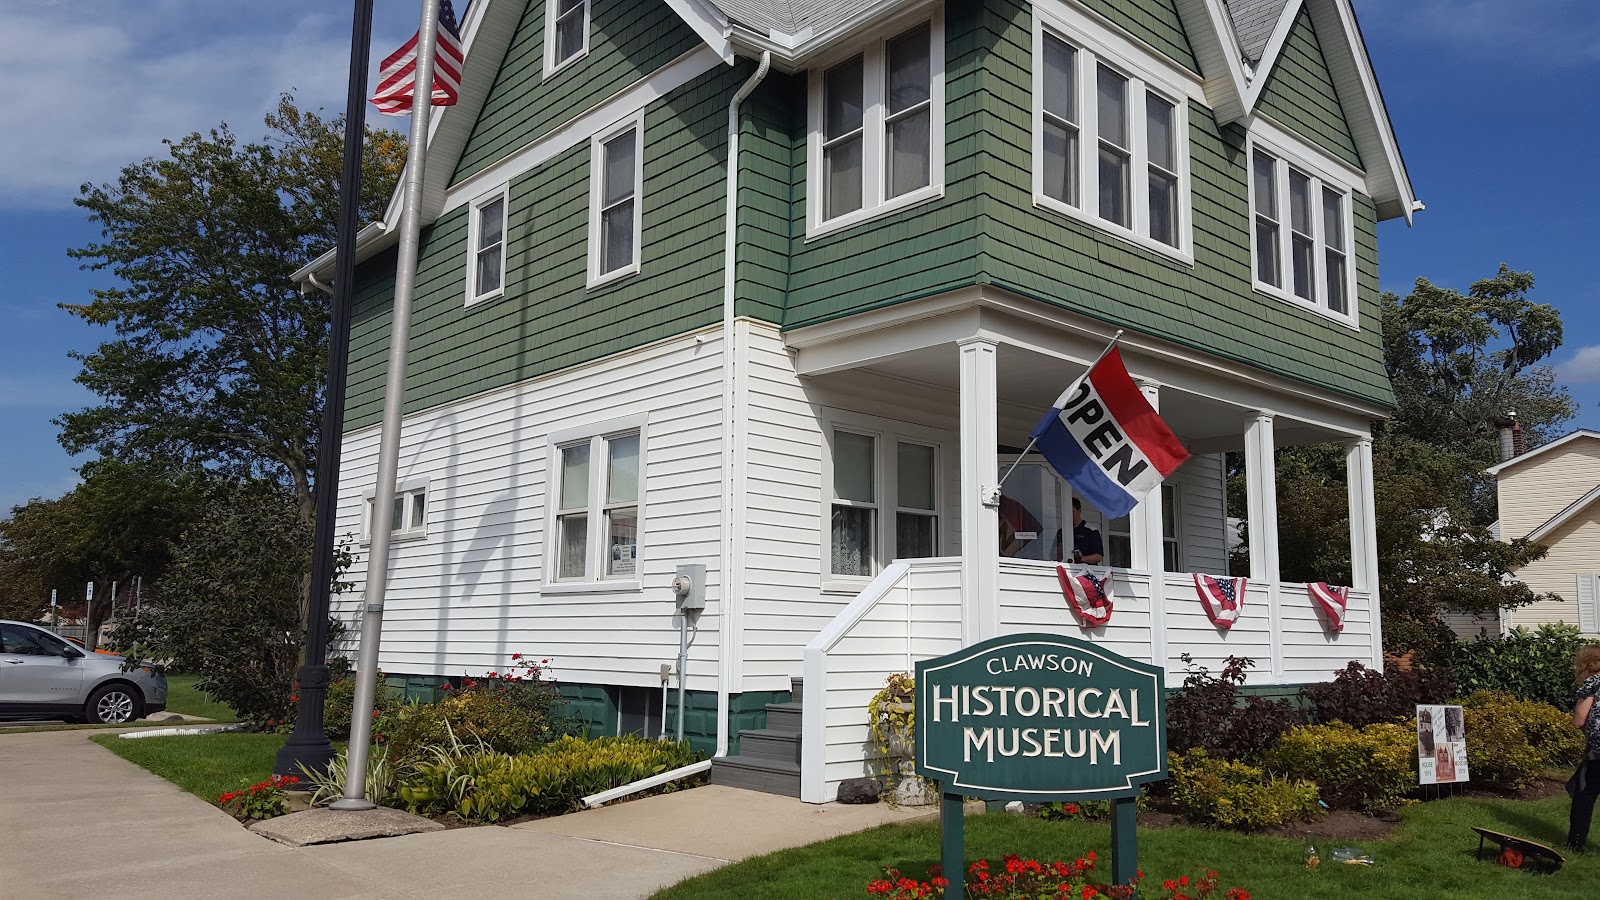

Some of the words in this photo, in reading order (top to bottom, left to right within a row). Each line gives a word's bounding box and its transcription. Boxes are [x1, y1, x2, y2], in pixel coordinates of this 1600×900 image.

[1063, 383, 1148, 486] OPEN
[986, 653, 1093, 678] CLAWSON
[932, 684, 1150, 727] HISTORICAL
[963, 726, 1121, 765] MUSEUM
